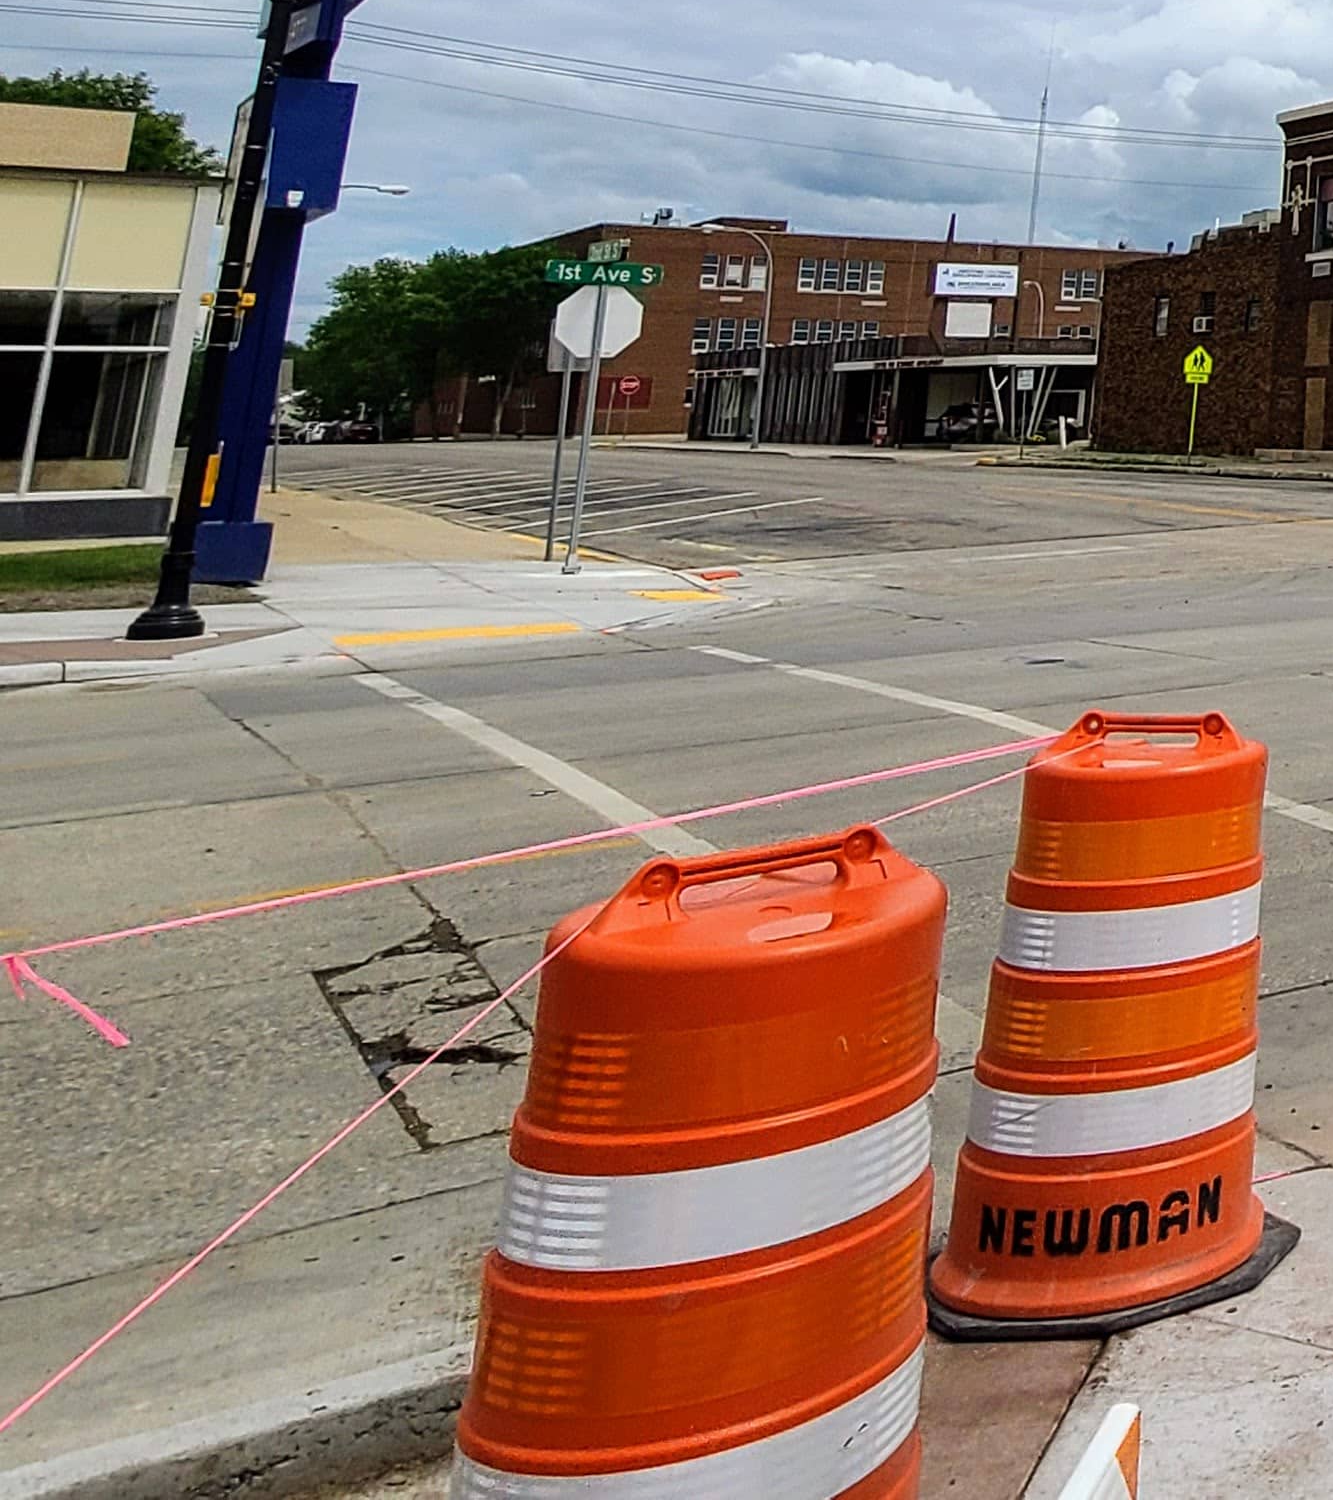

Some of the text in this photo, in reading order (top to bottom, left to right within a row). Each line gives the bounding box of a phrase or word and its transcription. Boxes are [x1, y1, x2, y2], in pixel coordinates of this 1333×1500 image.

[557, 264, 654, 283] 1st Ave S
[978, 1174, 1222, 1257] NEWMAN
